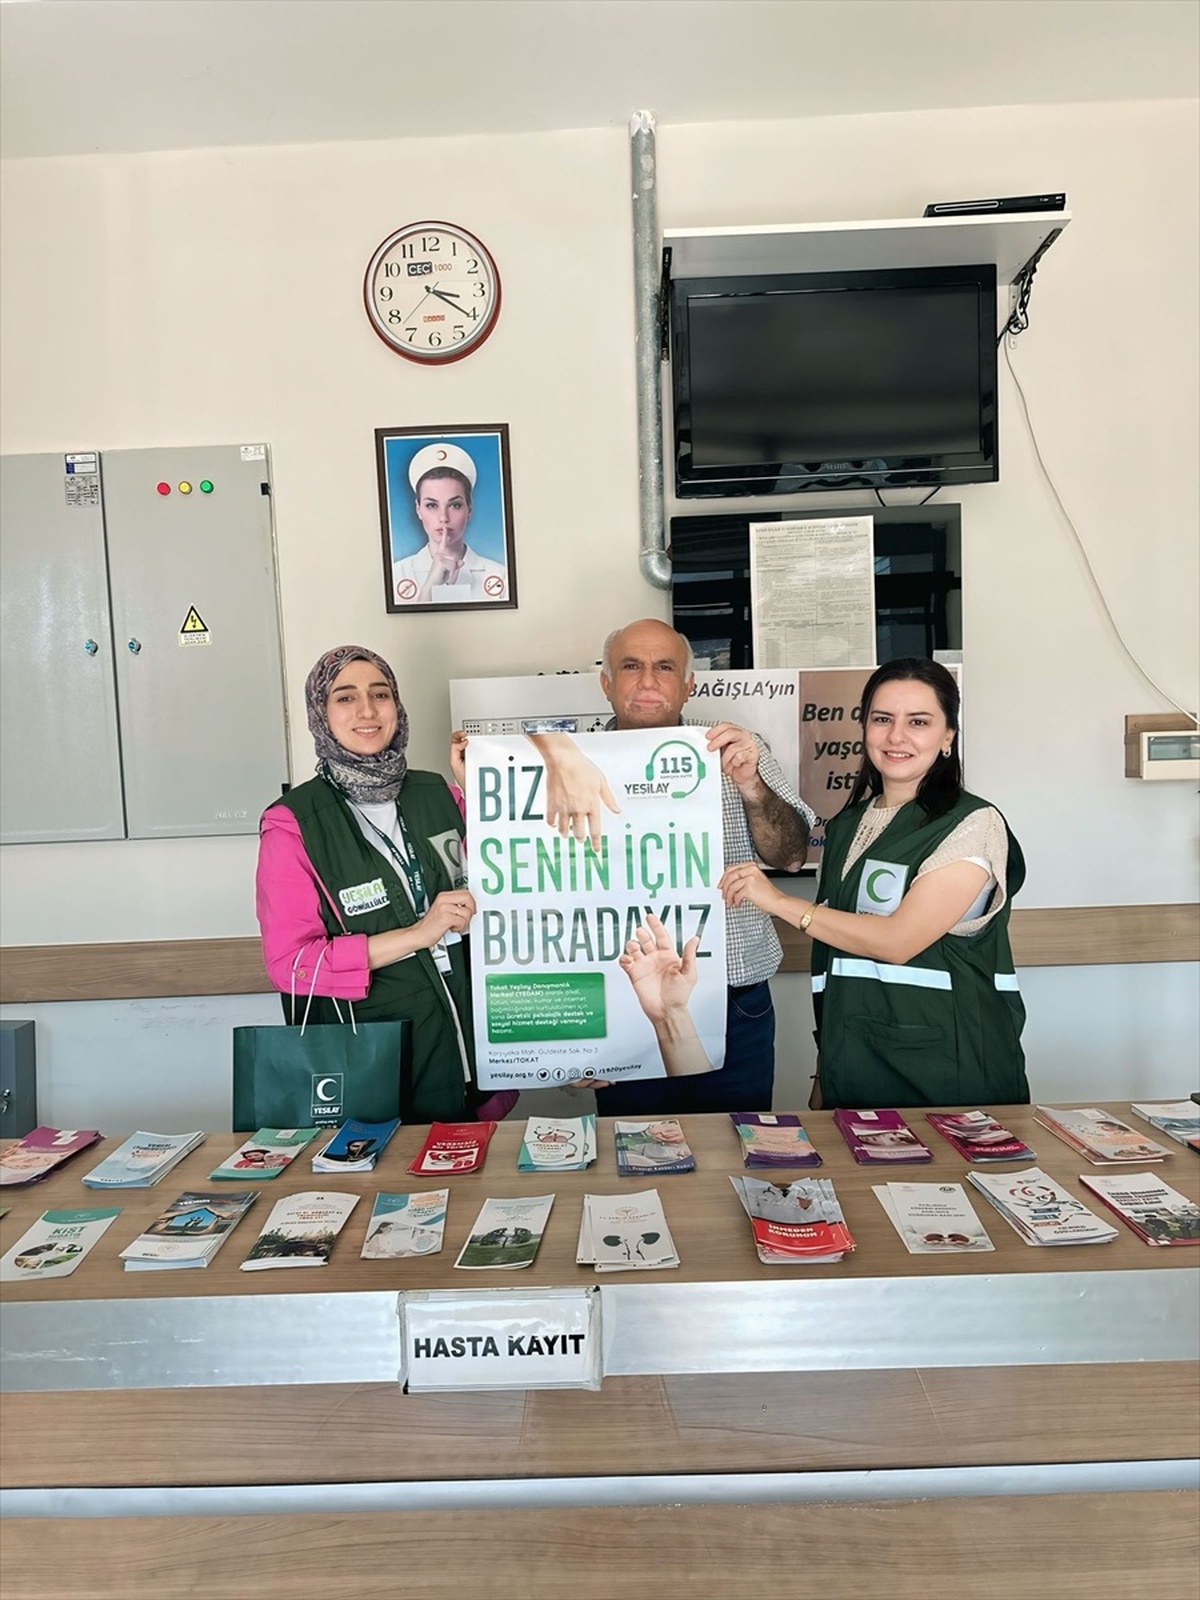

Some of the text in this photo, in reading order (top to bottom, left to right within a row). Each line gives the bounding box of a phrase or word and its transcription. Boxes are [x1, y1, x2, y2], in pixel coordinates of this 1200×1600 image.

[402, 244, 414, 258] 11
[422, 236, 440, 252] 12
[452, 242, 457, 256] 1
[385, 263, 400, 278] 10
[408, 263, 452, 274] CEC 1000
[466, 259, 478, 274] 2
[380, 286, 393, 302] 9
[473, 282, 485, 297] 3
[388, 309, 402, 324] 8
[467, 307, 479, 321] 4
[405, 328, 417, 342] 7
[429, 332, 441, 346] 6
[452, 325, 465, 341] 5
[802, 703, 844, 722] Ben
[660, 757, 692, 774] 115
[478, 756, 544, 822] BİZ
[625, 822, 711, 898] İÇİN
[414, 1334, 585, 1358] HASTA KAYIT
